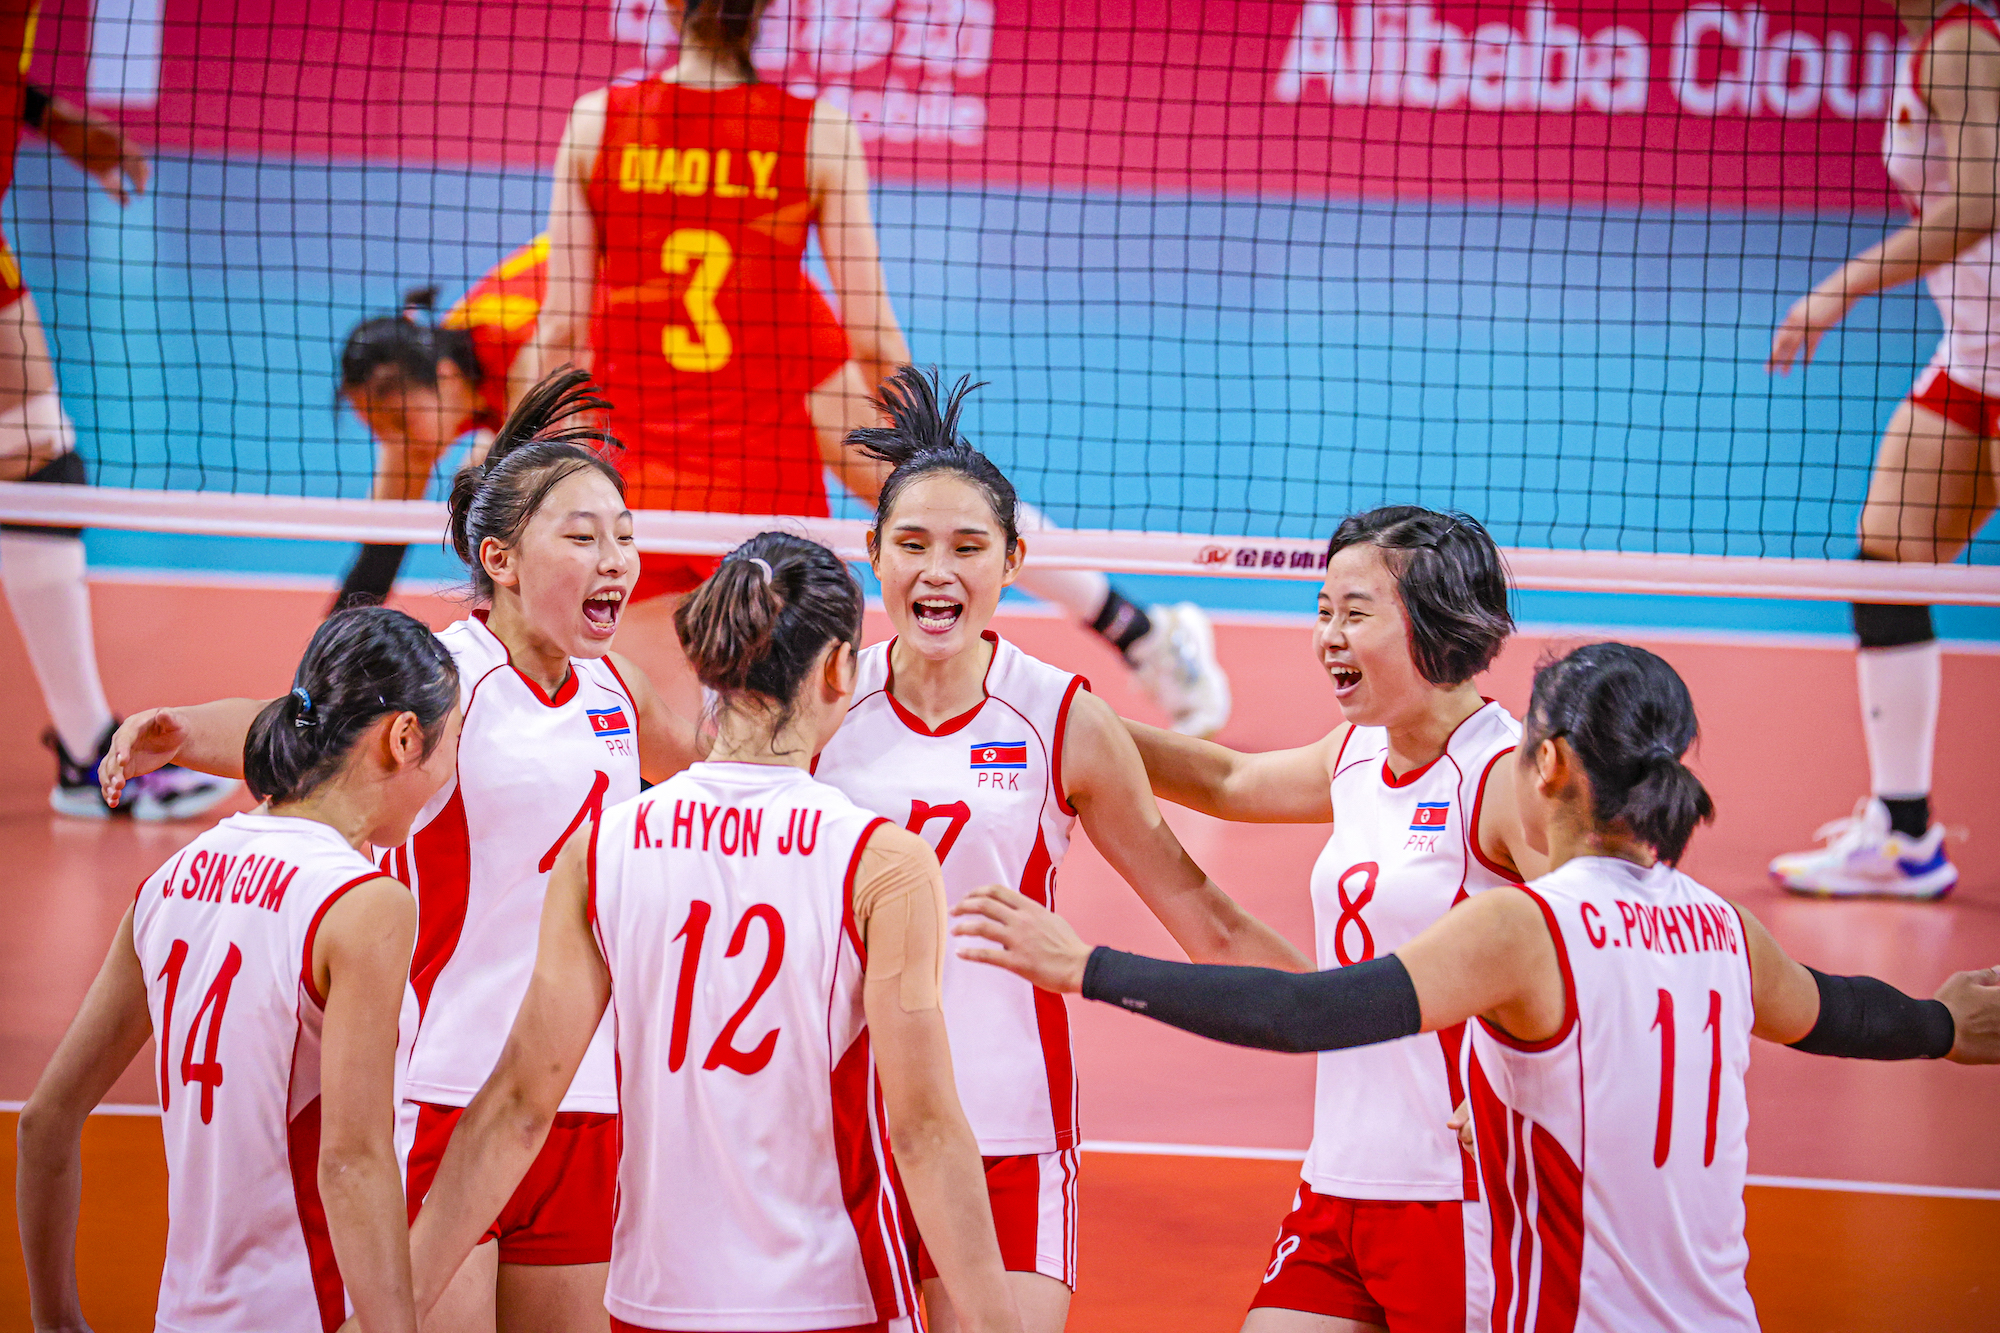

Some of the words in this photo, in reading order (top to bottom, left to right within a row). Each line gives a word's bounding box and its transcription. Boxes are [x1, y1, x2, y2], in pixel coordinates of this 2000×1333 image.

[1274, 0, 1651, 112] Alibaba
[1672, 2, 1911, 117] Clou
[660, 228, 733, 374] 3
[605, 738, 634, 757] PRK
[977, 771, 1020, 792] PRK
[777, 807, 822, 857] JU
[905, 798, 971, 868] 7
[1403, 834, 1440, 853] PRK
[1334, 860, 1380, 968] 8
[156, 938, 242, 1126] 14
[667, 899, 786, 1076] 12
[1650, 987, 1722, 1169] 11
[1262, 1234, 1301, 1284] 8
